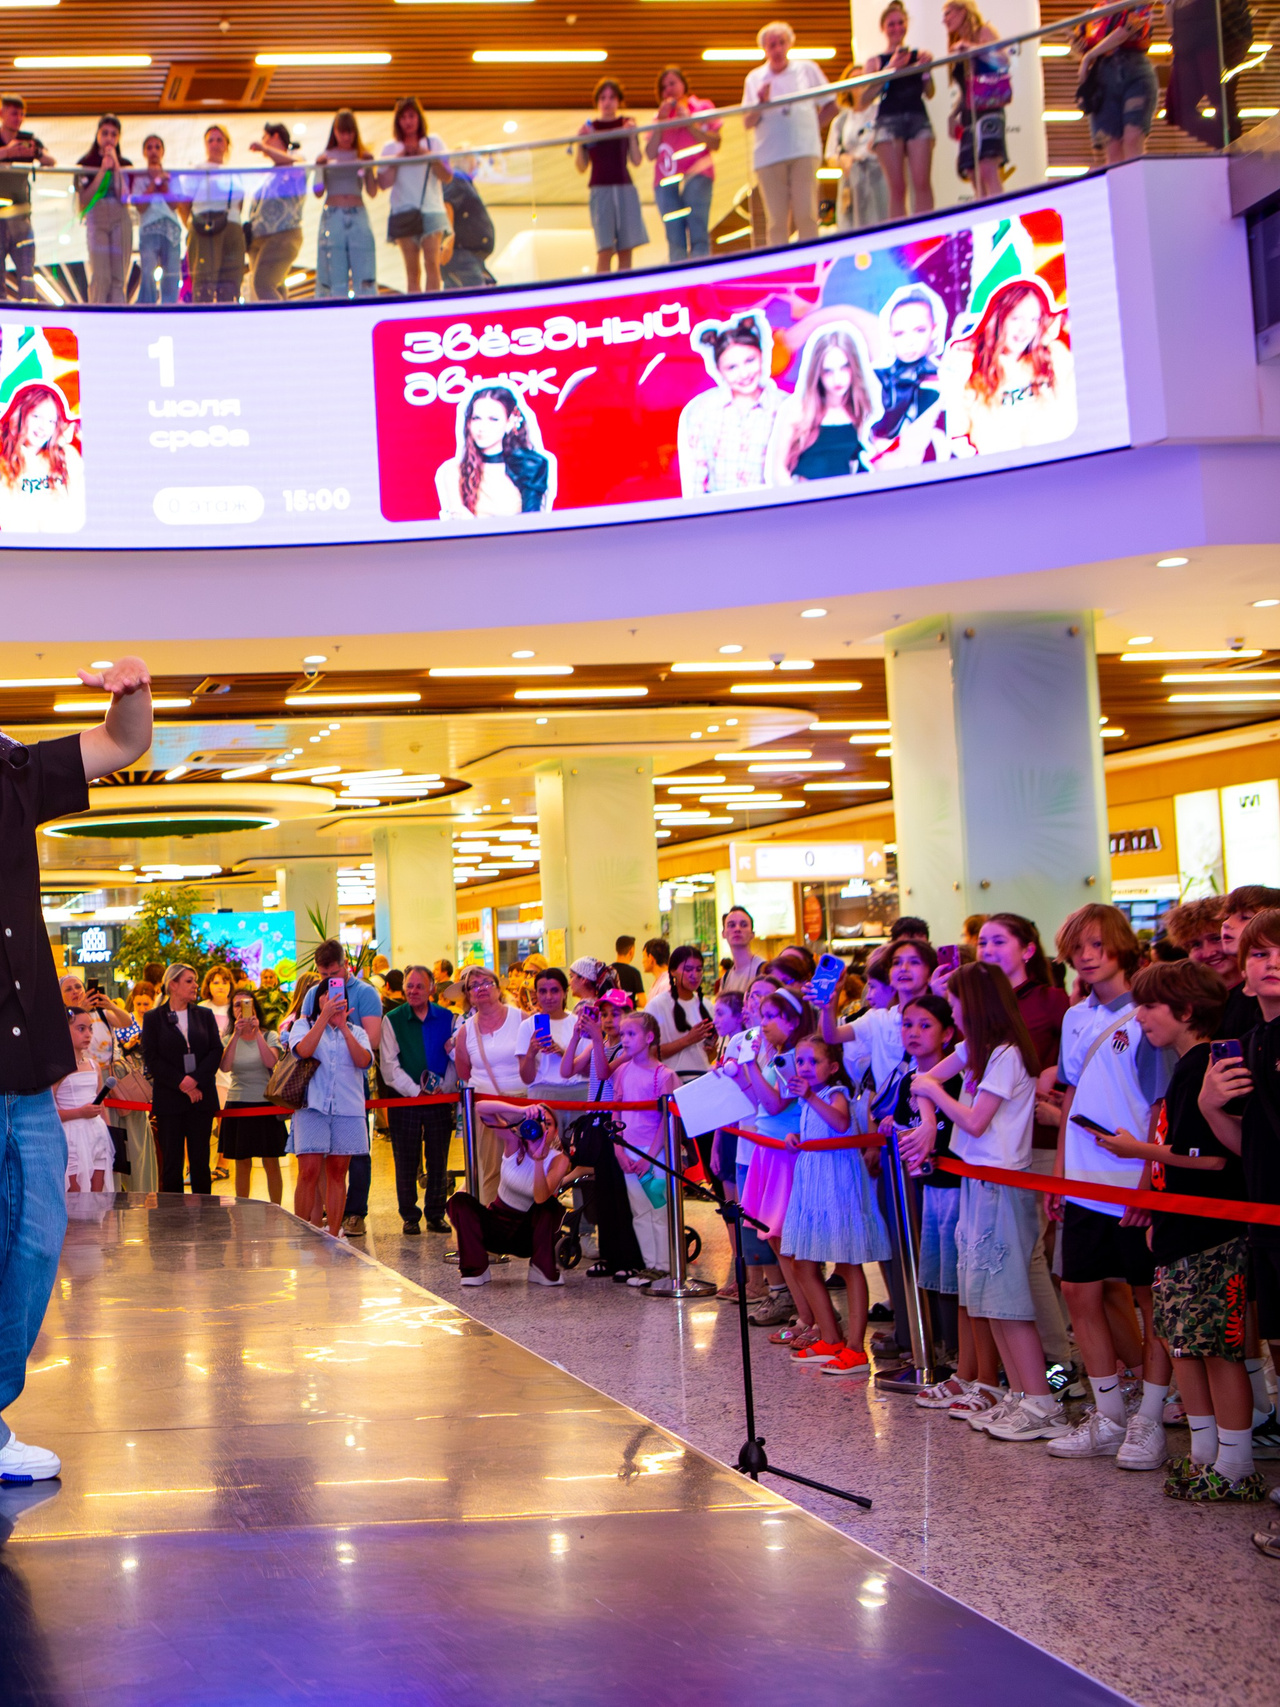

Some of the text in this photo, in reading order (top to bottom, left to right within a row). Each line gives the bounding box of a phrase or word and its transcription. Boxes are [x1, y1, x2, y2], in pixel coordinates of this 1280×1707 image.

[402, 302, 690, 363] Звёздный
[148, 335, 175, 387] 1
[148, 398, 241, 418] июля
[149, 424, 250, 453] среда
